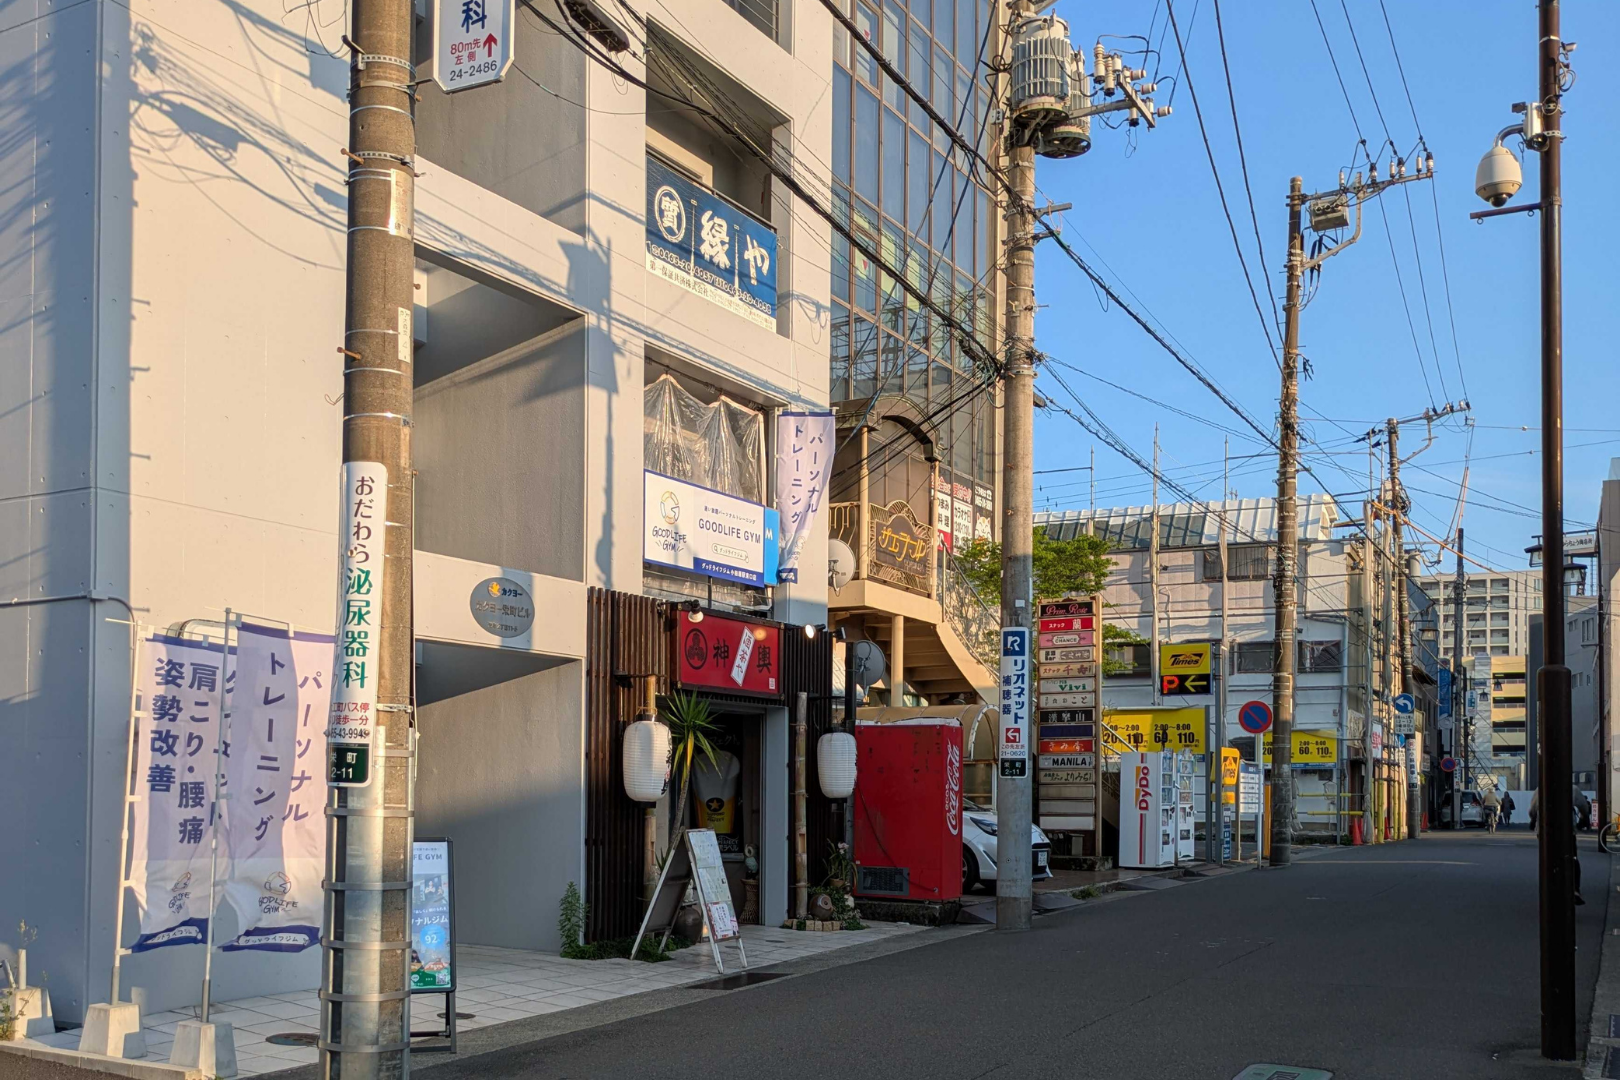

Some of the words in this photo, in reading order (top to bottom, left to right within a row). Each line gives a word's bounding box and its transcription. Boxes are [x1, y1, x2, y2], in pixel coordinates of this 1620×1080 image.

[450, 38, 481, 55] 80m先
[450, 60, 497, 81] 24-2486
[791, 424, 804, 525] トレーニング
[805, 432, 824, 515] パーソナル
[652, 525, 687, 544] GOODLIFE
[698, 518, 741, 539] GOODLIFE
[743, 530, 761, 544] GYM
[662, 539, 677, 553] GYM
[501, 587, 523, 598] カクヨー
[1170, 654, 1201, 667] Times
[1002, 674, 1012, 716] 補聴器
[1012, 658, 1026, 725] リオネット
[1163, 675, 1180, 694] P
[146, 657, 187, 794] 姿勢改善
[254, 651, 286, 842] トレーニング
[281, 670, 323, 823] パーソナル
[331, 766, 354, 780] 2-11
[1052, 757, 1087, 766] MANILA
[946, 738, 960, 836] Coca-Cola
[1138, 765, 1153, 811] DyDo
[424, 934, 438, 944] 92
